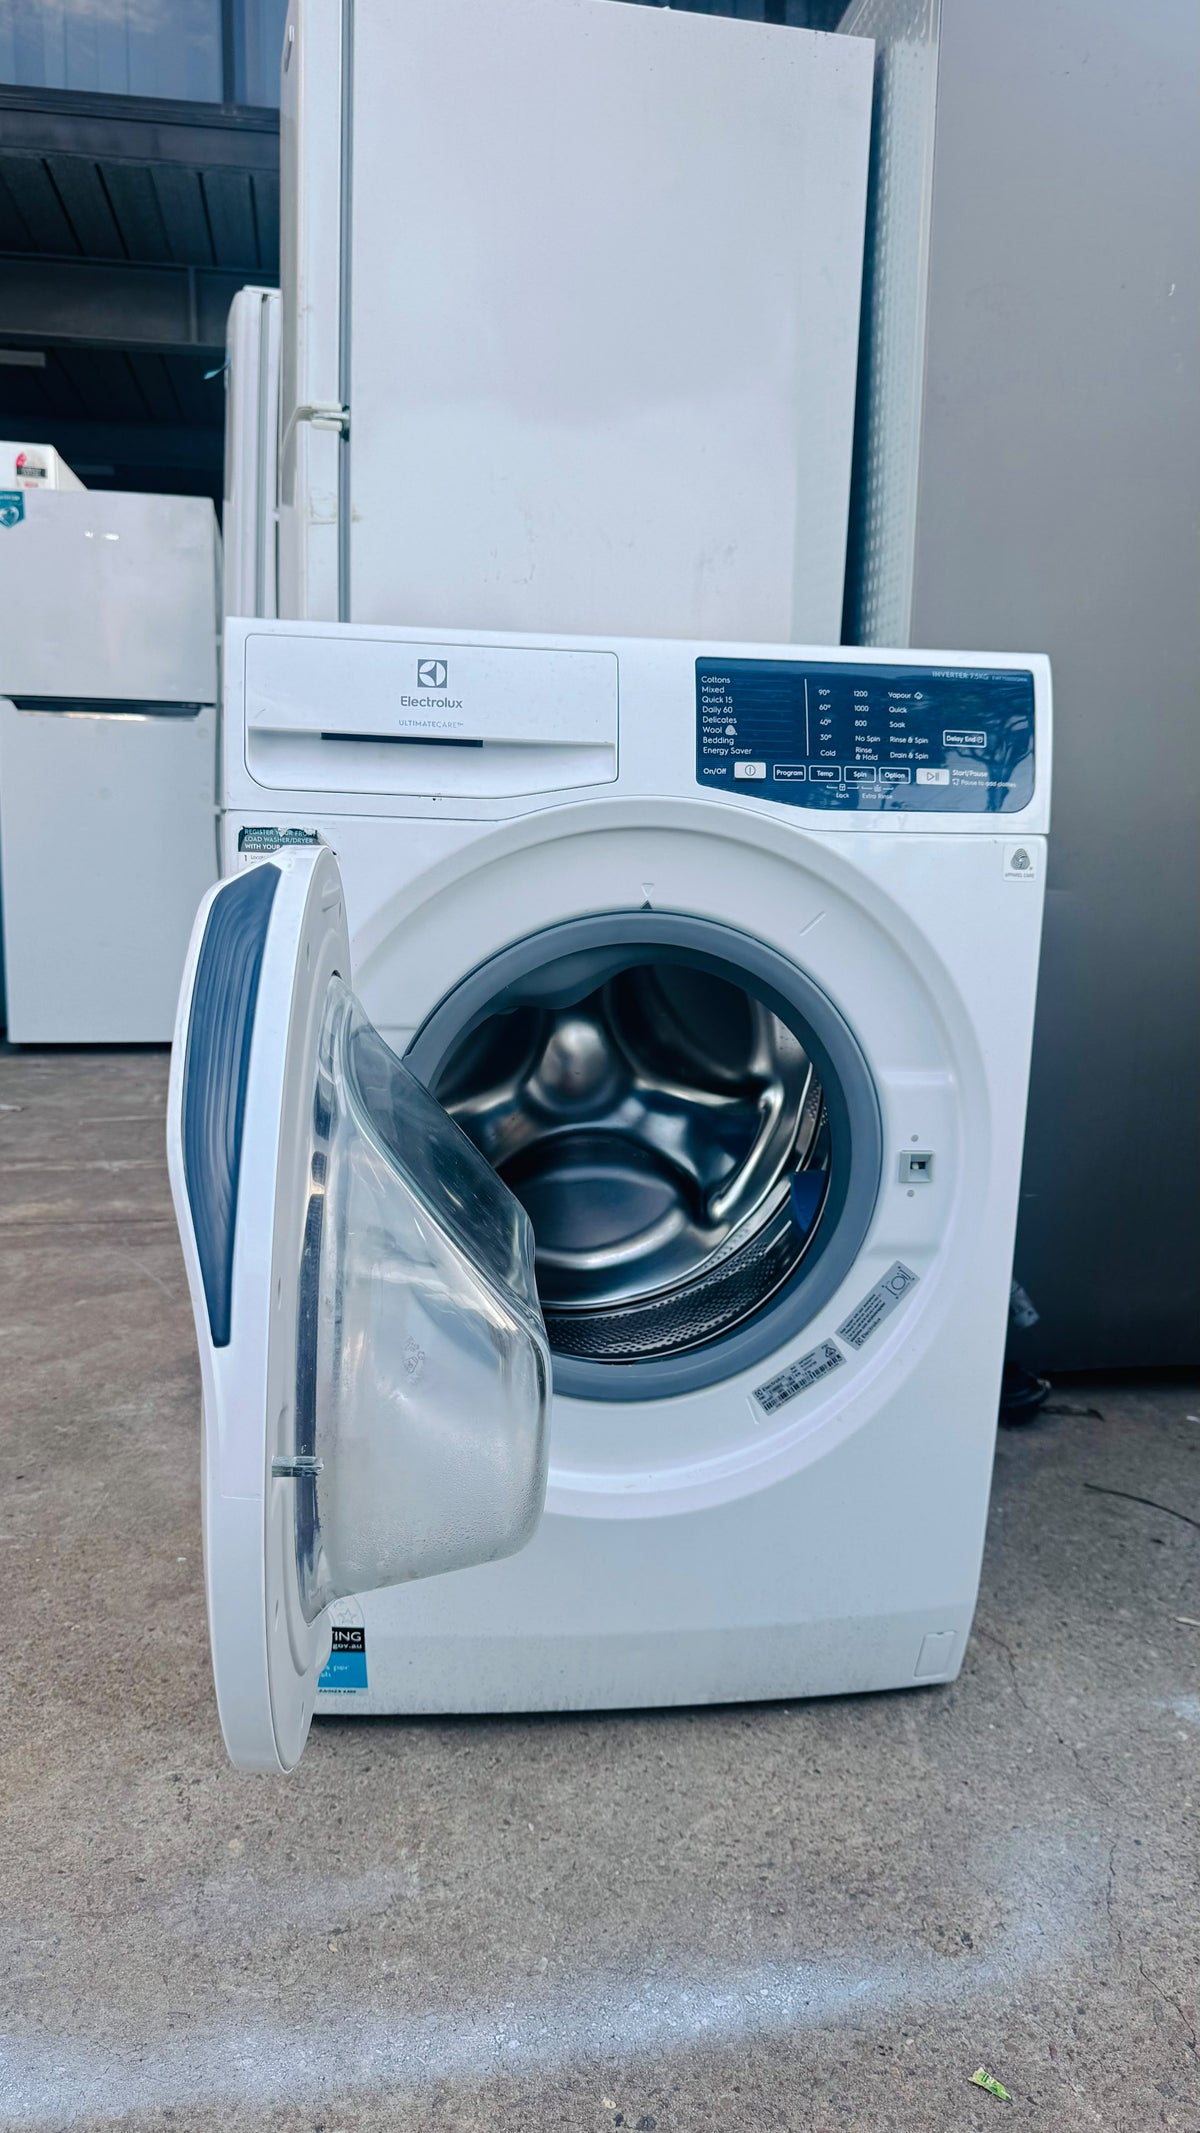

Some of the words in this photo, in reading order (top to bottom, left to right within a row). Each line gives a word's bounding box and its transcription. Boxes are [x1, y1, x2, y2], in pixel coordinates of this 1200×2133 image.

[932, 671, 970, 679] INVERTER
[701, 676, 731, 684] Cottons
[701, 686, 725, 694] Mixed
[888, 691, 912, 700] Vapour
[401, 696, 462, 708] Electrolux
[702, 696, 724, 704] Quick
[702, 706, 721, 715] Daily
[723, 706, 733, 714] 60
[888, 706, 907, 714] Quick
[703, 716, 738, 724] Delicates
[703, 726, 723, 734] Wool
[703, 737, 735, 746] Bedding
[866, 735, 880, 743] Spin
[914, 737, 929, 745] Spin
[946, 735, 964, 743] Delay
[703, 747, 729, 756] Energy
[731, 747, 753, 755] Saver
[855, 746, 873, 754] Rinse
[890, 751, 907, 759] Drain
[914, 752, 929, 760] Spin
[703, 767, 727, 775] On/Off
[776, 769, 804, 778] Program
[816, 770, 834, 778] Temp
[853, 770, 867, 779] Spin
[952, 769, 989, 778] Start/Pause
[884, 771, 906, 780] Option
[862, 792, 877, 800] Extra
[274, 829, 293, 837] YUR
[332, 1630, 362, 1642] ING
